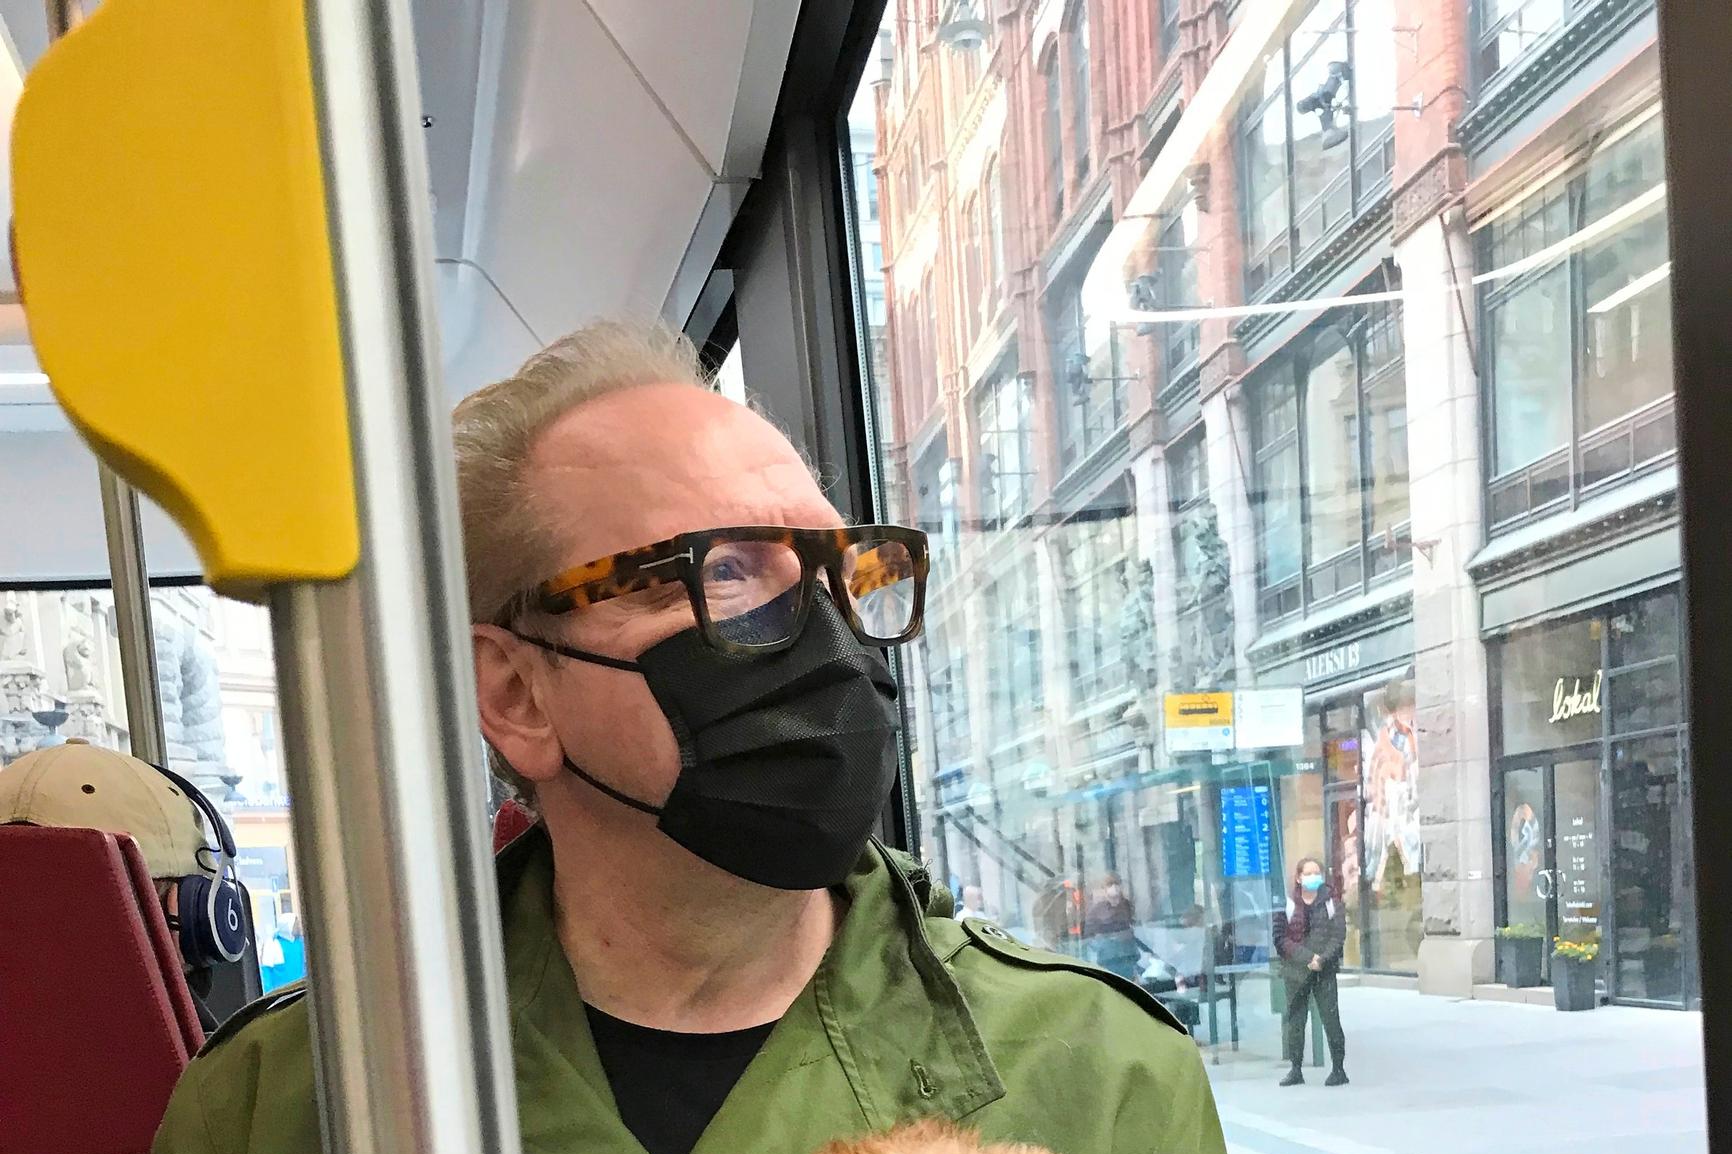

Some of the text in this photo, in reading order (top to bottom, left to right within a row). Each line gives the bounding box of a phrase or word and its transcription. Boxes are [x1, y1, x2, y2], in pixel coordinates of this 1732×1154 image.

[1304, 642, 1360, 681] ALEKSI 13
[1548, 669, 1602, 723] lokal
